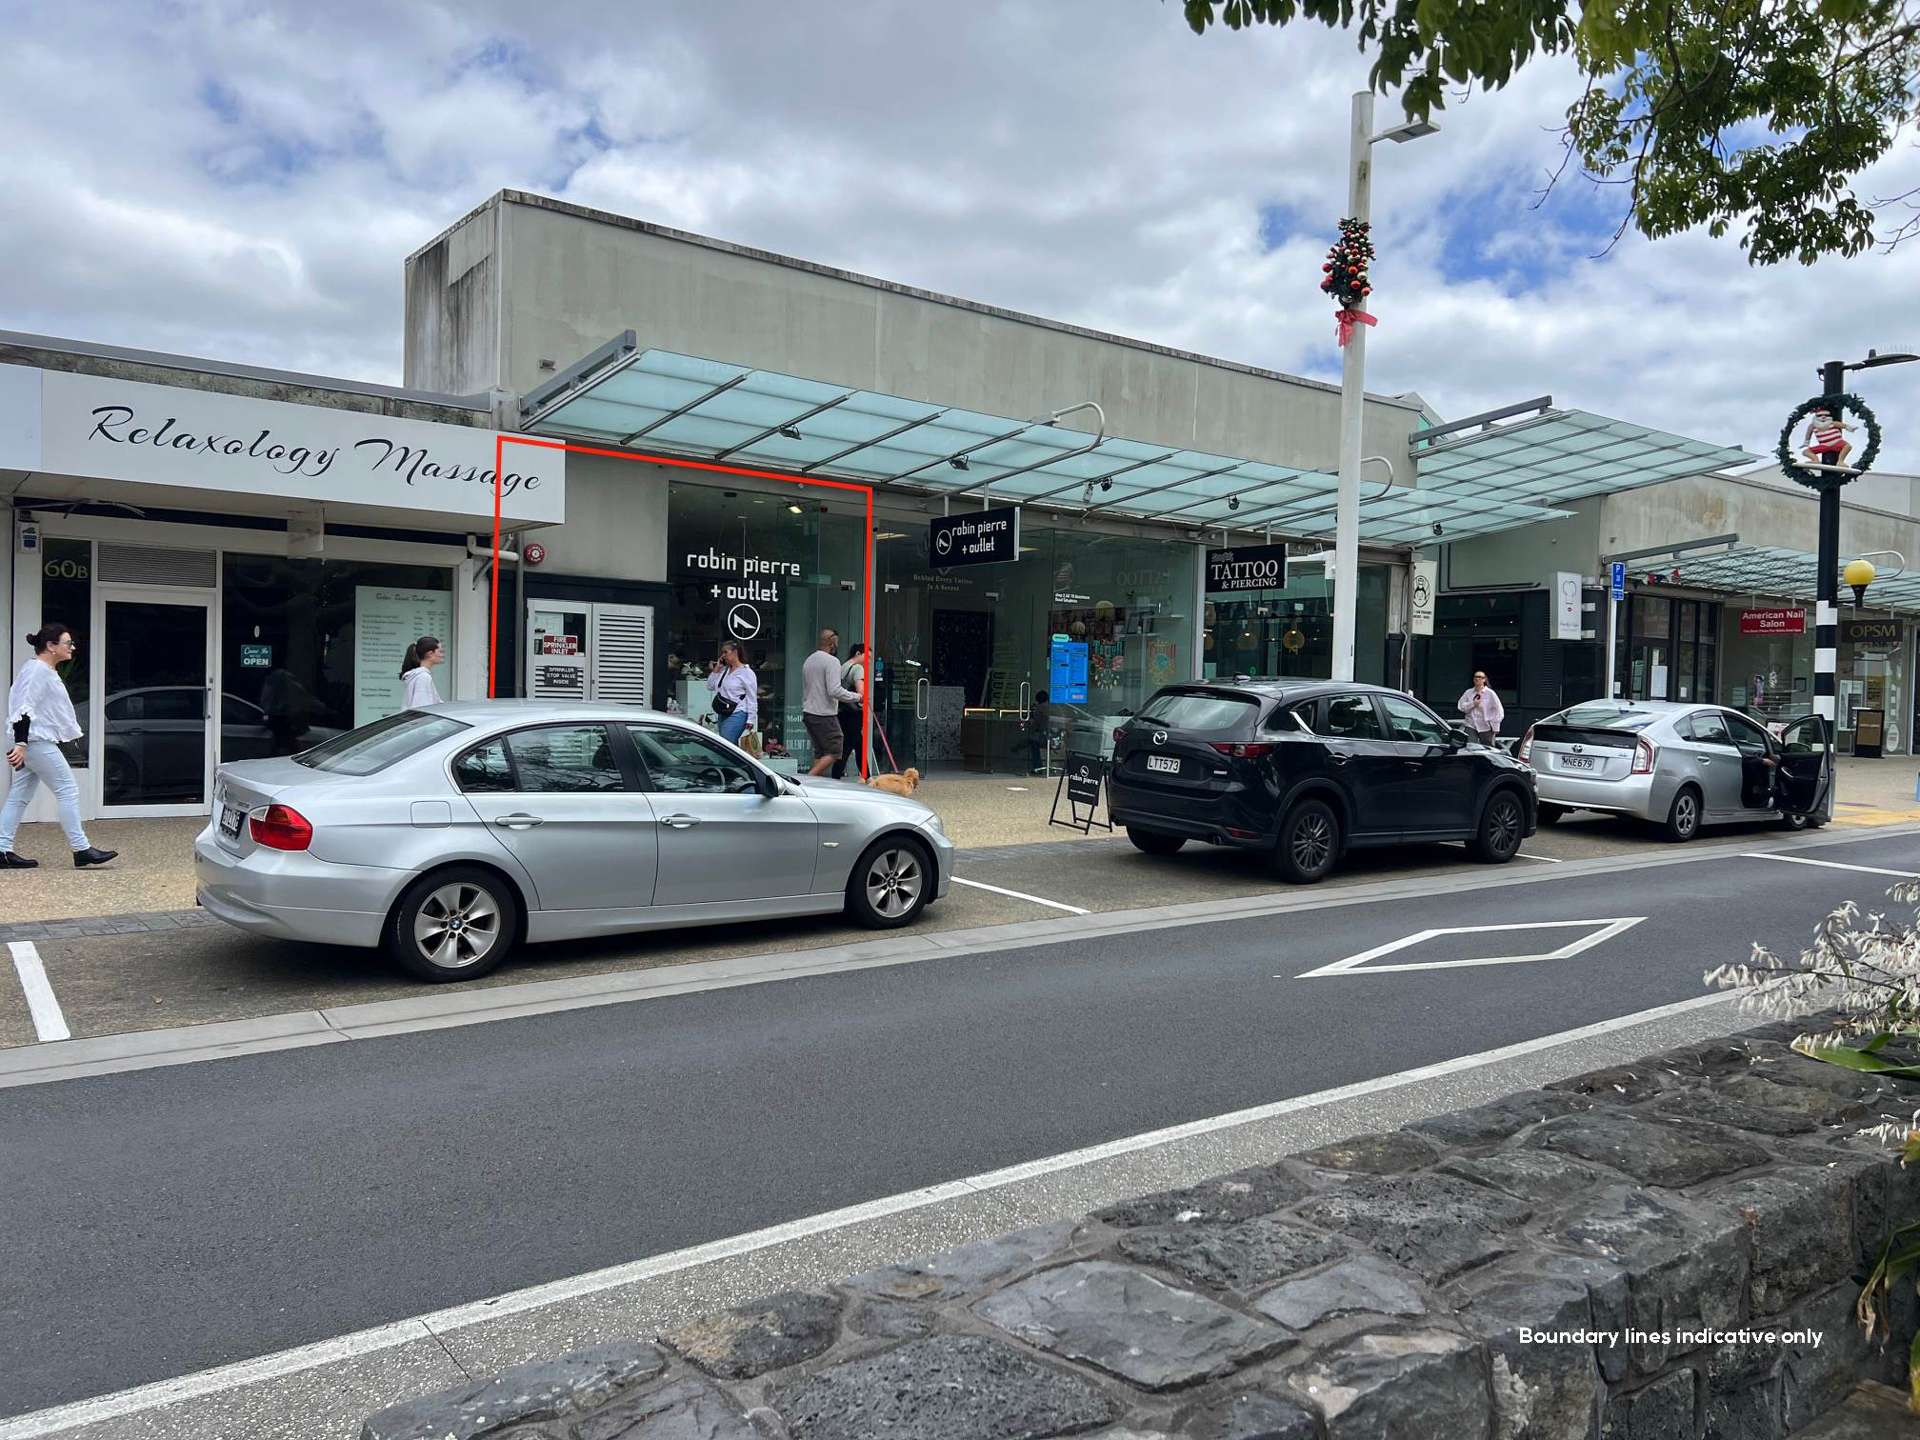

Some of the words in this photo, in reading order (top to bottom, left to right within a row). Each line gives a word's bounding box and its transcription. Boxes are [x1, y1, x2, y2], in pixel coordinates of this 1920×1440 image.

[88, 405, 341, 477] Relaxology
[354, 438, 541, 497] Massage
[952, 520, 975, 536] robin
[978, 520, 1007, 537] pierre
[969, 536, 995, 553] outlet
[44, 559, 89, 579] 60B
[687, 547, 737, 571] robin
[743, 555, 800, 578] pierre
[1210, 559, 1279, 580] TATTOO
[727, 580, 779, 602] outlet
[1221, 580, 1230, 590] &
[1230, 577, 1277, 590] PIERCING
[1742, 611, 1785, 620] American
[1786, 610, 1804, 618] Nail
[1759, 620, 1785, 628] Salon
[1850, 624, 1896, 638] OPSM
[243, 657, 269, 666] OPEN
[1148, 756, 1180, 772] LTT573
[1561, 756, 1593, 769] MNE679
